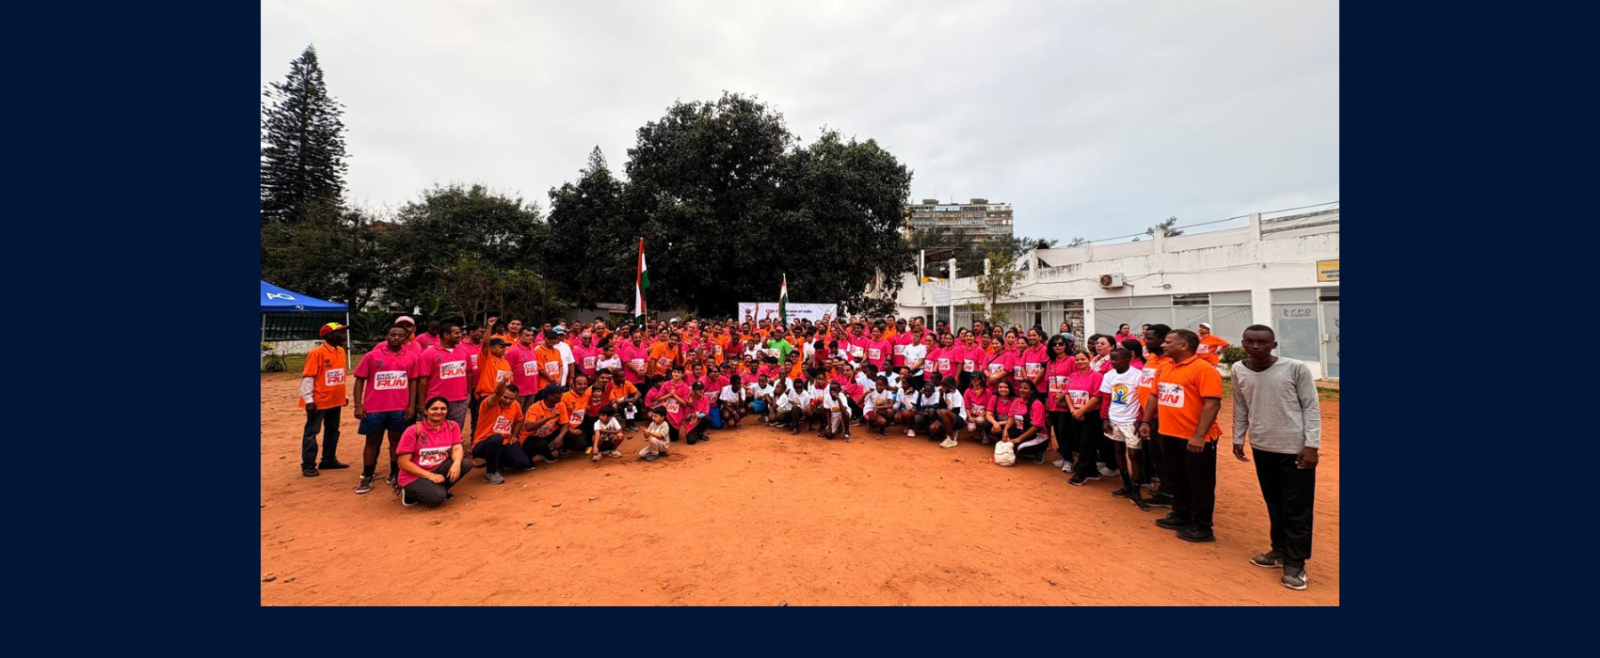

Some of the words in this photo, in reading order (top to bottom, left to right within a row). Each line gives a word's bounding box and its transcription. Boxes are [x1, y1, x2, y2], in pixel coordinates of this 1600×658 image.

[442, 368, 465, 377] RUN
[327, 376, 344, 384] RU
[376, 379, 406, 388] RUN
